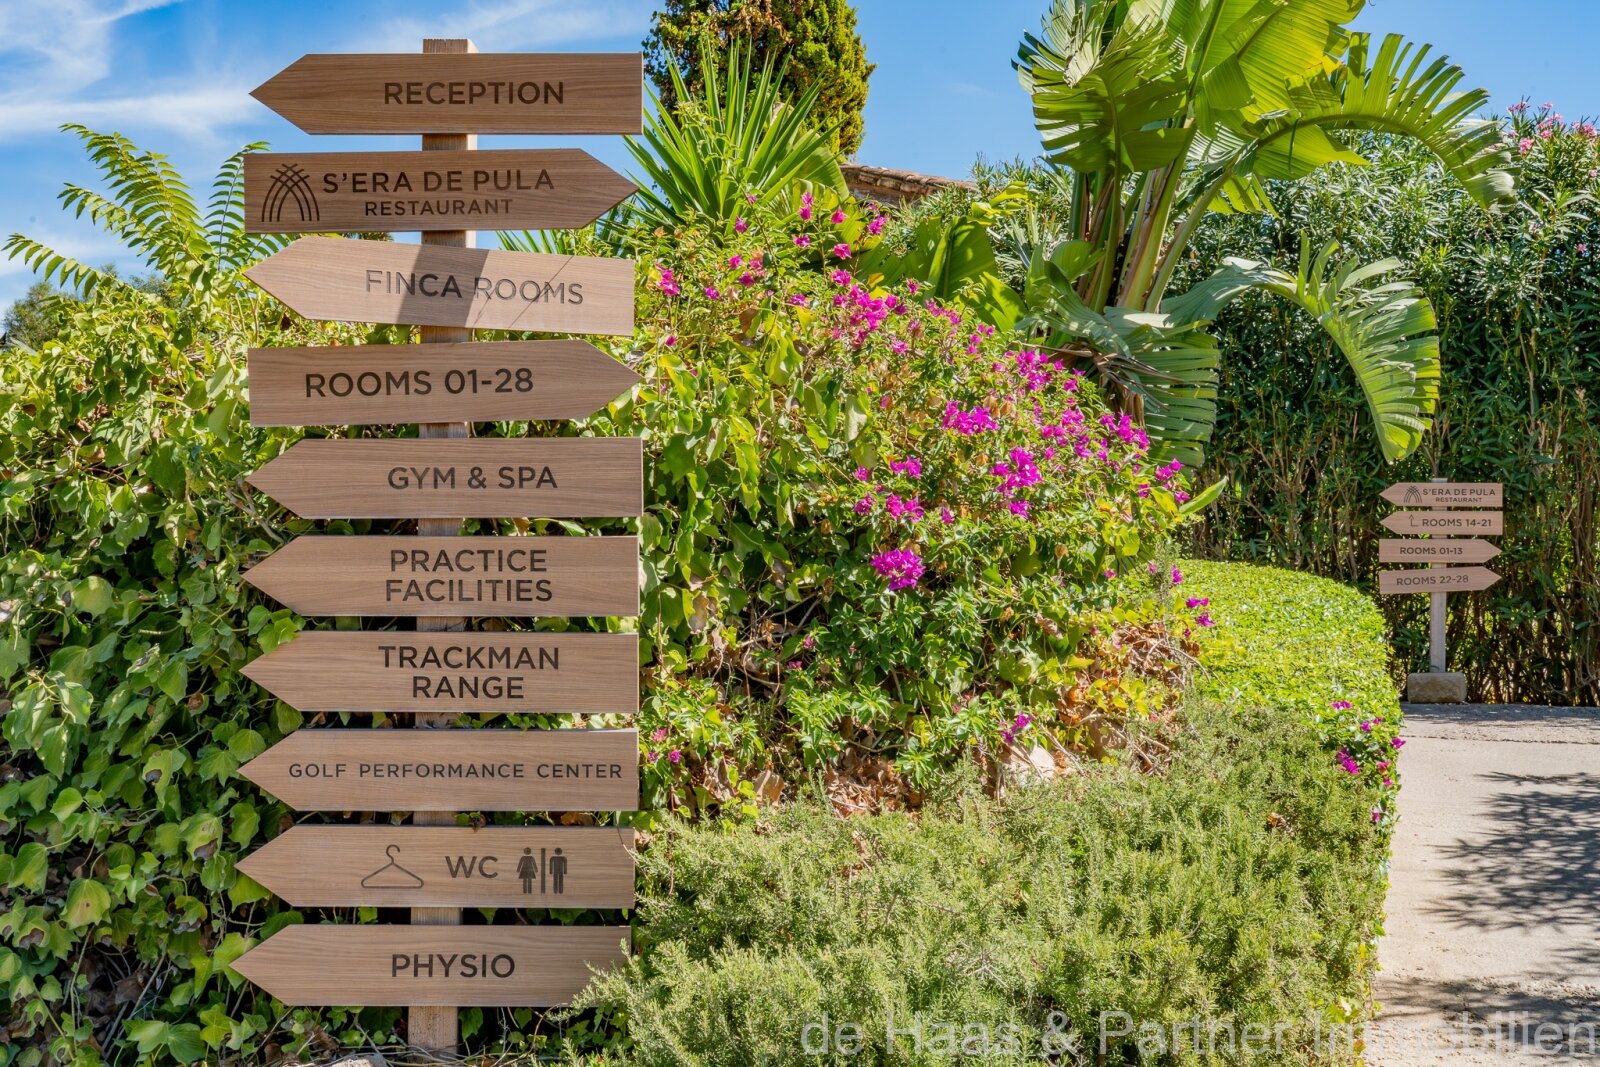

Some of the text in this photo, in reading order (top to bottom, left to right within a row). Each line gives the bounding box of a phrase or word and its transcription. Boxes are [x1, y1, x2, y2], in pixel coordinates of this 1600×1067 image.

[384, 82, 564, 104] RECEPTION
[323, 169, 555, 194] S'ERA DE PULA
[365, 199, 513, 216] RESTAURANT
[365, 269, 584, 305] FINCA ROOMS
[305, 367, 534, 398] ROOMS 01-28
[387, 466, 558, 490] GYM & SPA
[1422, 488, 1496, 496] S'ERA DE PULA
[1422, 518, 1492, 527] ROOMS 14-21
[390, 549, 547, 573] PRACTICE
[1400, 547, 1463, 555] ROOMS 01-13
[385, 579, 552, 602] FACILITIES
[1396, 575, 1469, 586] ROOMS 22-28
[378, 645, 559, 670] TRACKMAN
[413, 675, 525, 699] RANGE
[288, 763, 622, 779] GOLF PERFORMANCE CENTER
[445, 855, 498, 879] WC
[391, 953, 515, 978] PHYSIO
